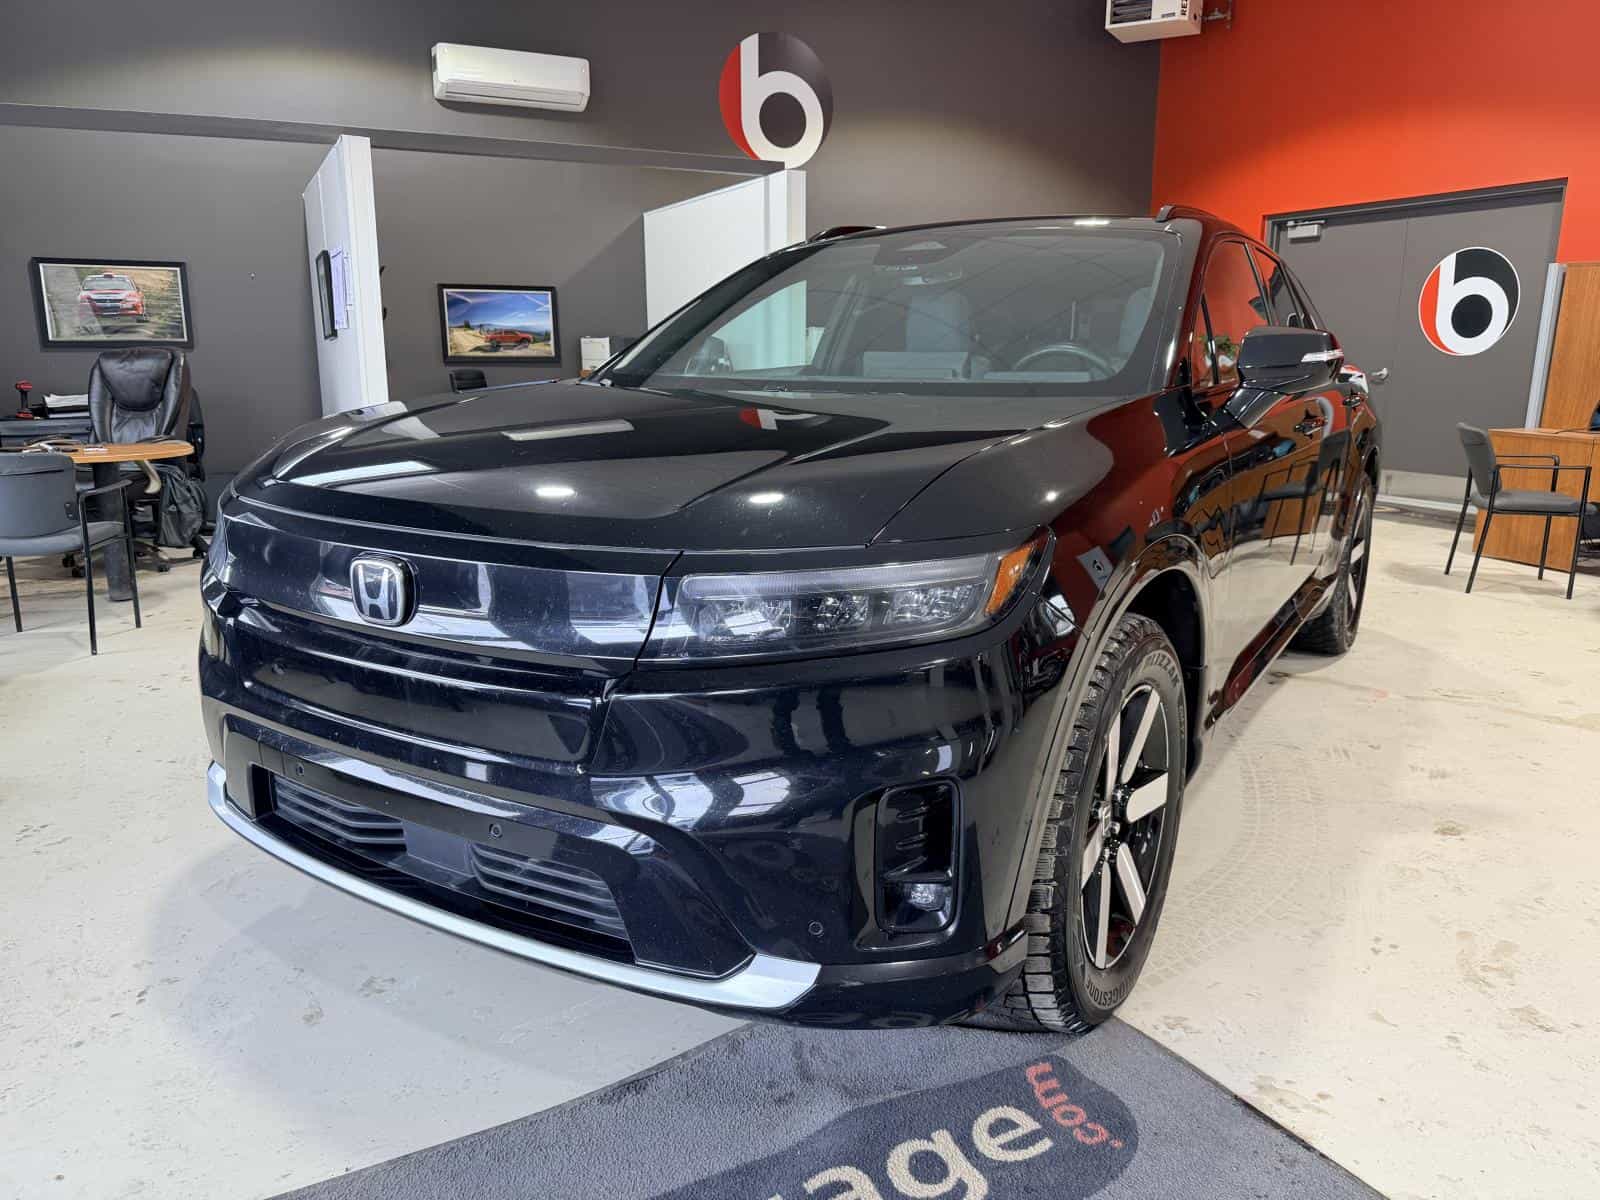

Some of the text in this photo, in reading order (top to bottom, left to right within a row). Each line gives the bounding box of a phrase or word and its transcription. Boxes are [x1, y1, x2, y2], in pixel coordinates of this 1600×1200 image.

[1180, 0, 1188, 16] RE
[740, 32, 824, 170] b
[1435, 252, 1509, 356] b
[768, 1105, 1054, 1200] age
[1025, 1061, 1123, 1149] .com
